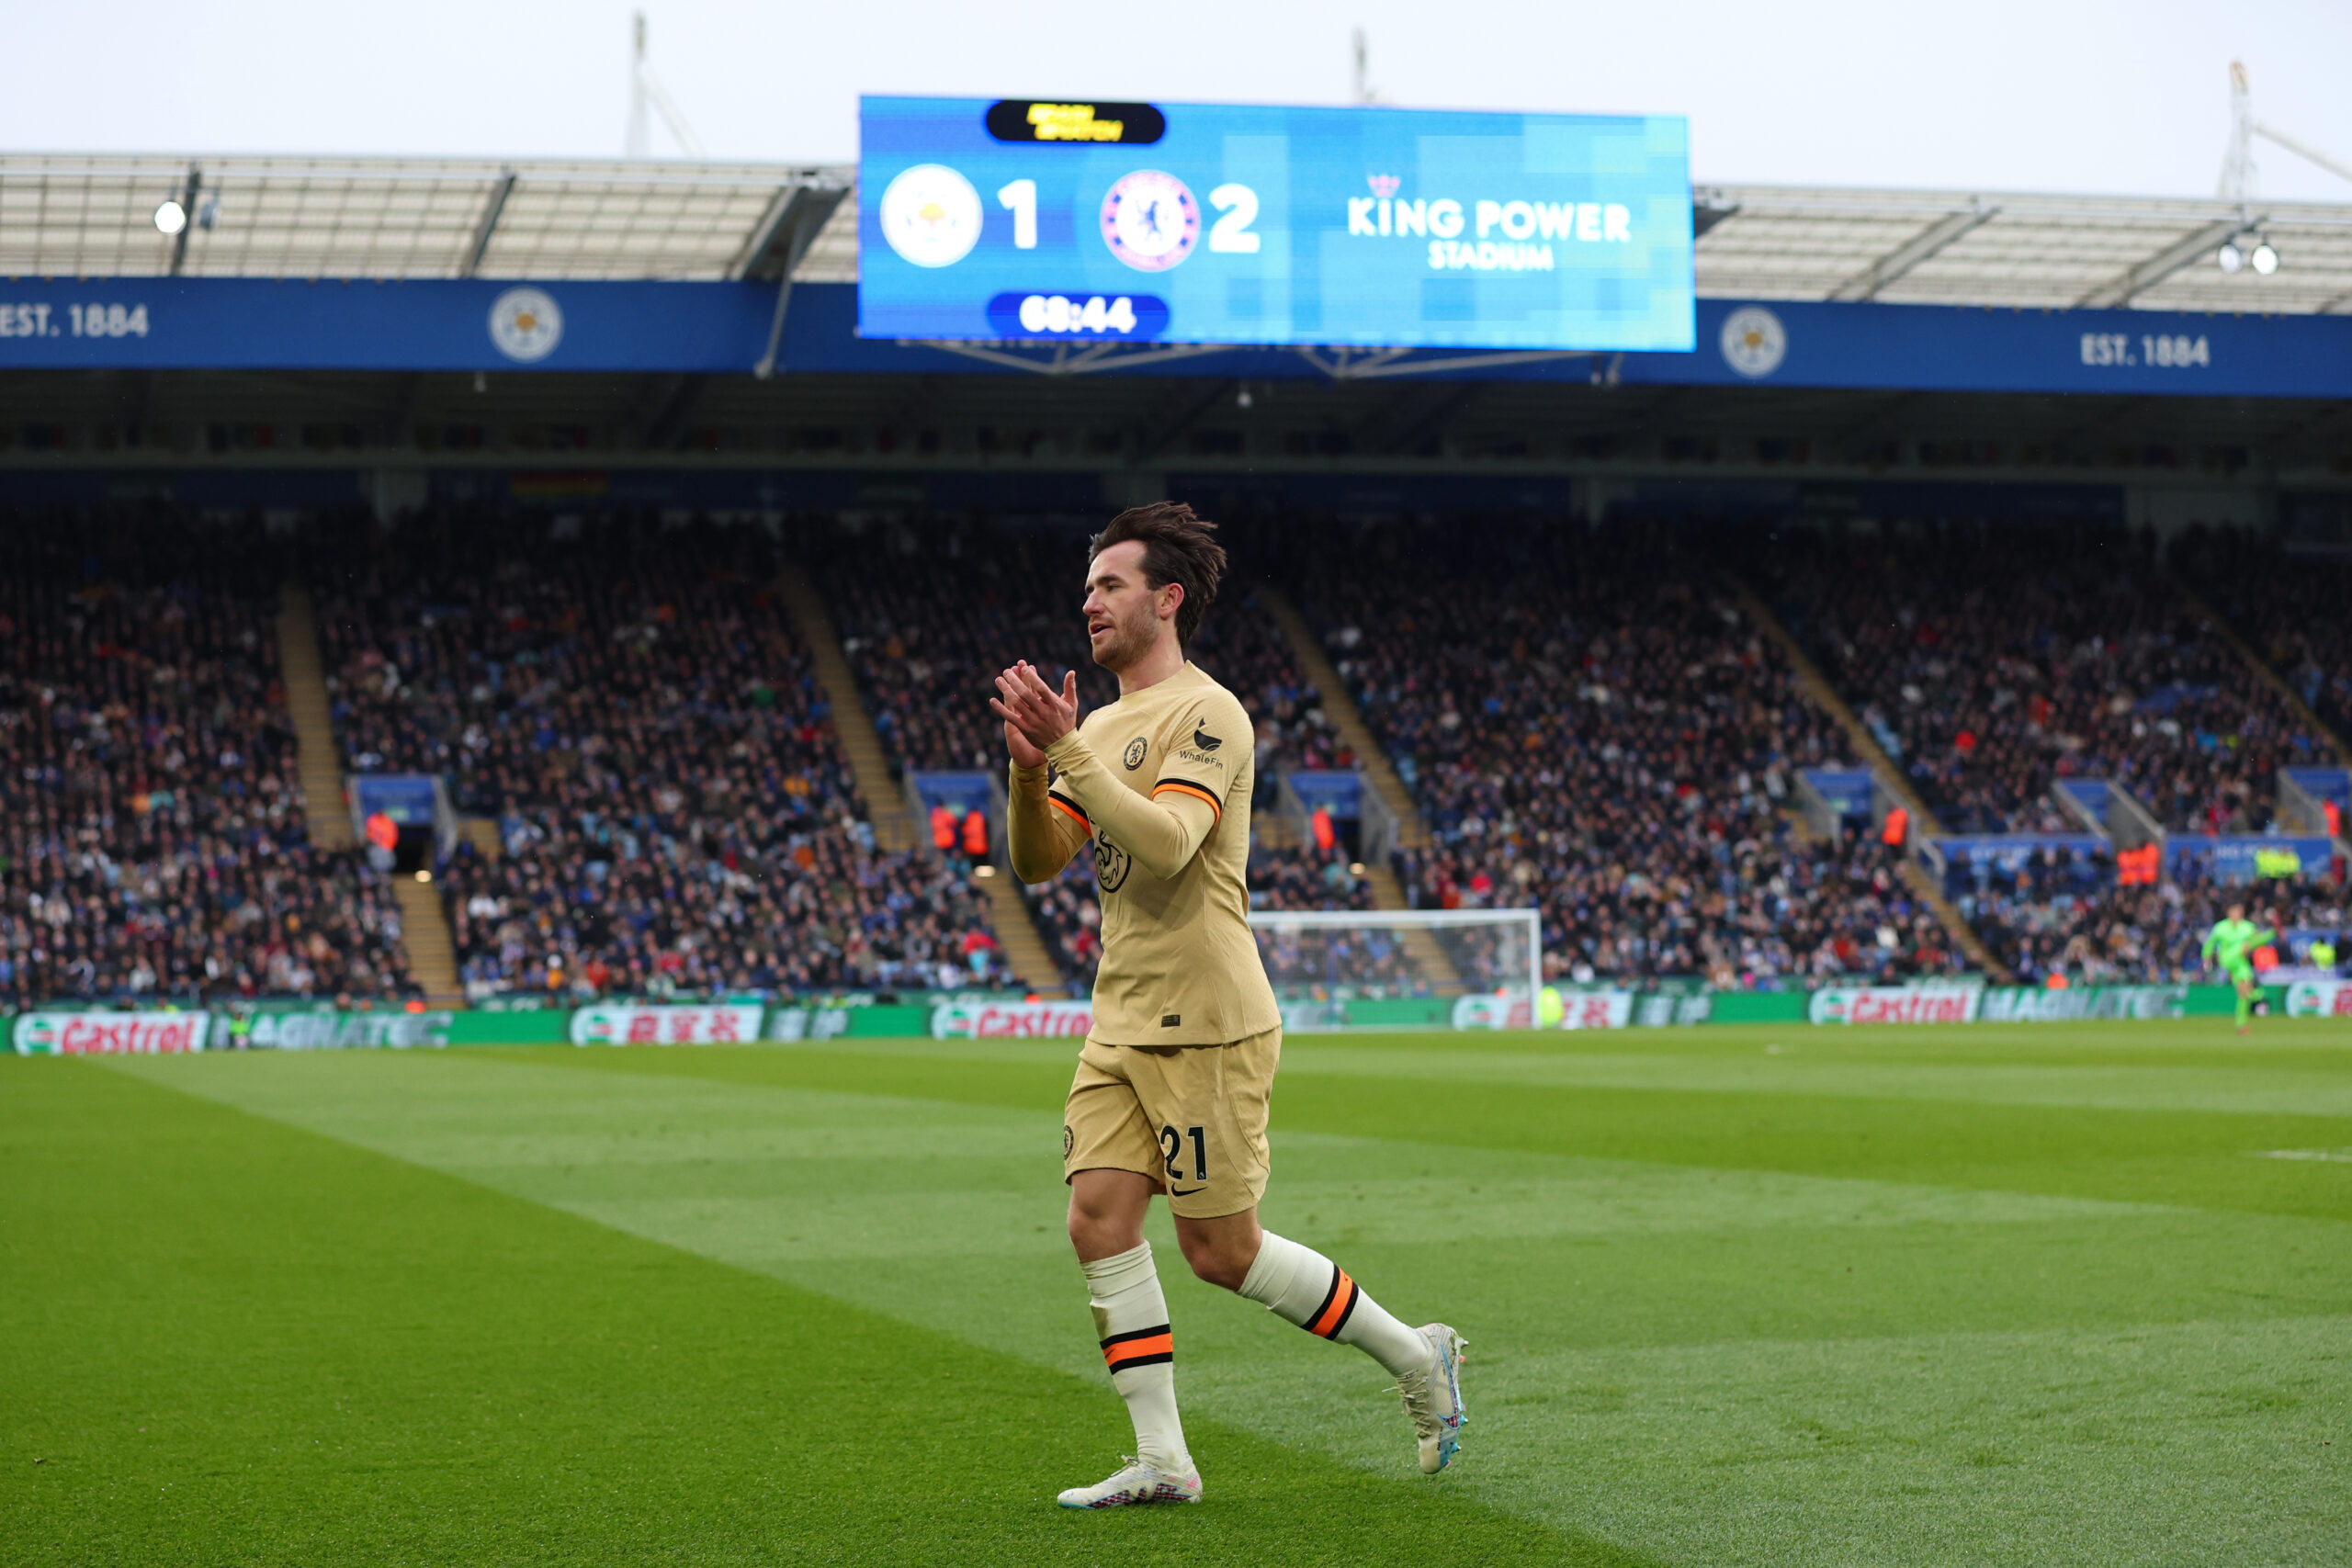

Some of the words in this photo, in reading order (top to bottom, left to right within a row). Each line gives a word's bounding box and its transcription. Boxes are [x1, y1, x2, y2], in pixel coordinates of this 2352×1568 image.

[998, 179, 1038, 249] 1
[1208, 184, 1261, 254] 2
[1347, 197, 1466, 240] KING
[1475, 199, 1632, 243] POWER
[1428, 240, 1555, 272] STADIUM
[0, 304, 60, 337] EST.
[70, 304, 149, 337] 1884
[2080, 333, 2136, 367] EST.
[2142, 334, 2210, 368] 1884
[1180, 750, 1224, 770] WhaleFin
[978, 1007, 1093, 1037] Castro
[1850, 989, 1968, 1023] Castrol
[60, 1014, 196, 1055] Castrol
[1159, 1124, 1208, 1181] 21
